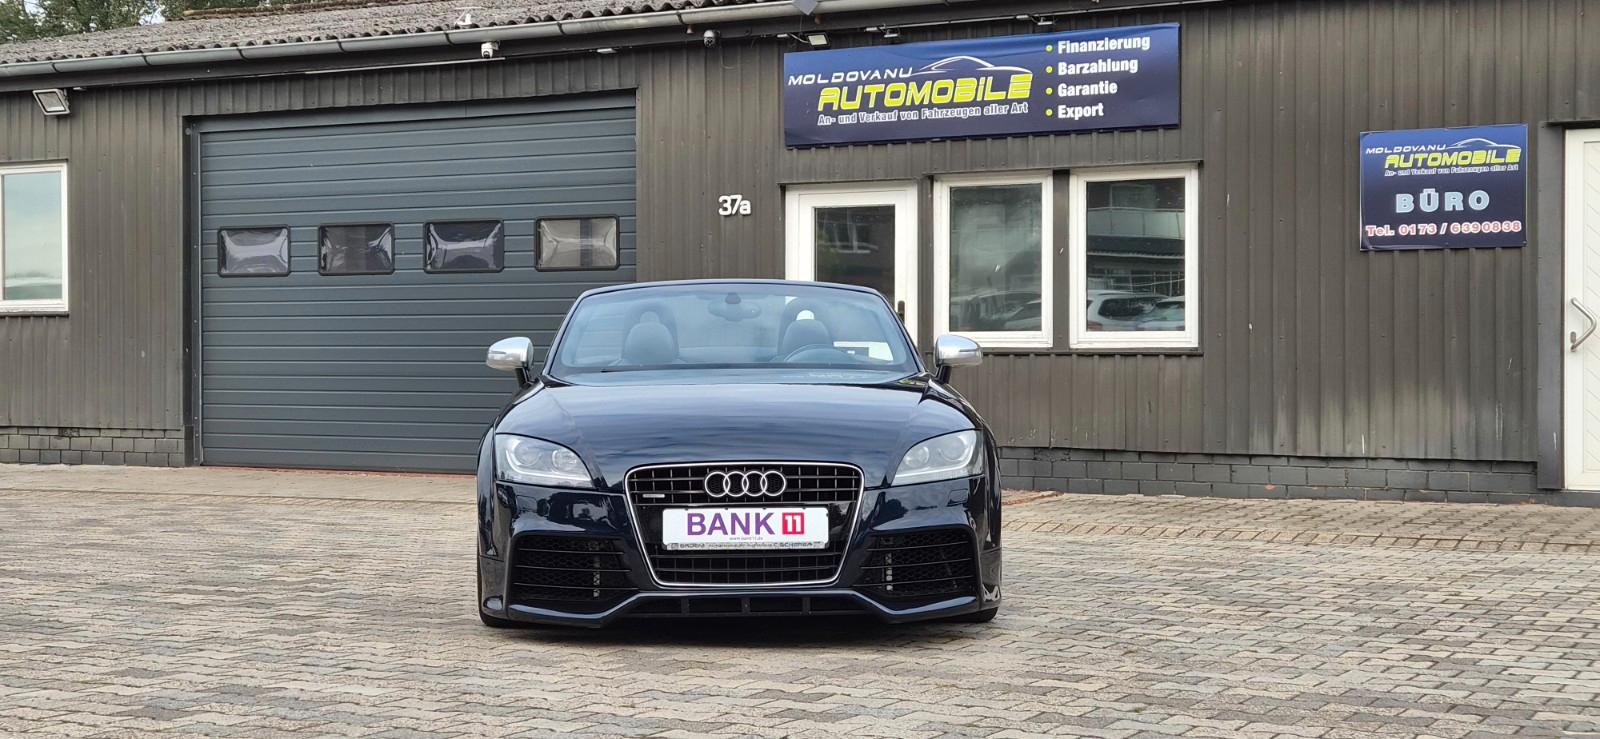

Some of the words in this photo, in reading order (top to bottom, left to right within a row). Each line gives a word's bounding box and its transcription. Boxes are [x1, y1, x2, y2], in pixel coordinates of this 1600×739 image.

[1058, 36, 1151, 54] Finanzierung
[1058, 58, 1138, 75] Barzahlung
[788, 67, 912, 86] MOLDOVANU
[1058, 80, 1118, 97] Garantie
[817, 114, 836, 126] An-
[838, 112, 857, 124] und
[859, 110, 899, 123] Verkauf
[900, 110, 919, 121] von
[921, 106, 982, 120] Fahrzeugen
[984, 103, 1009, 116] aller
[1010, 101, 1029, 114] Art
[1058, 102, 1104, 120] Export
[1366, 144, 1446, 154] MOLDOVANU
[1384, 149, 1521, 169] AUTOMOBILE
[719, 194, 752, 216] 37a
[1395, 188, 1490, 213] BÜRO
[1366, 224, 1395, 237] Tel.
[1400, 223, 1438, 236] 0173
[1450, 220, 1522, 235] 6390838
[687, 512, 776, 536] BANK
[784, 514, 801, 533] 11
